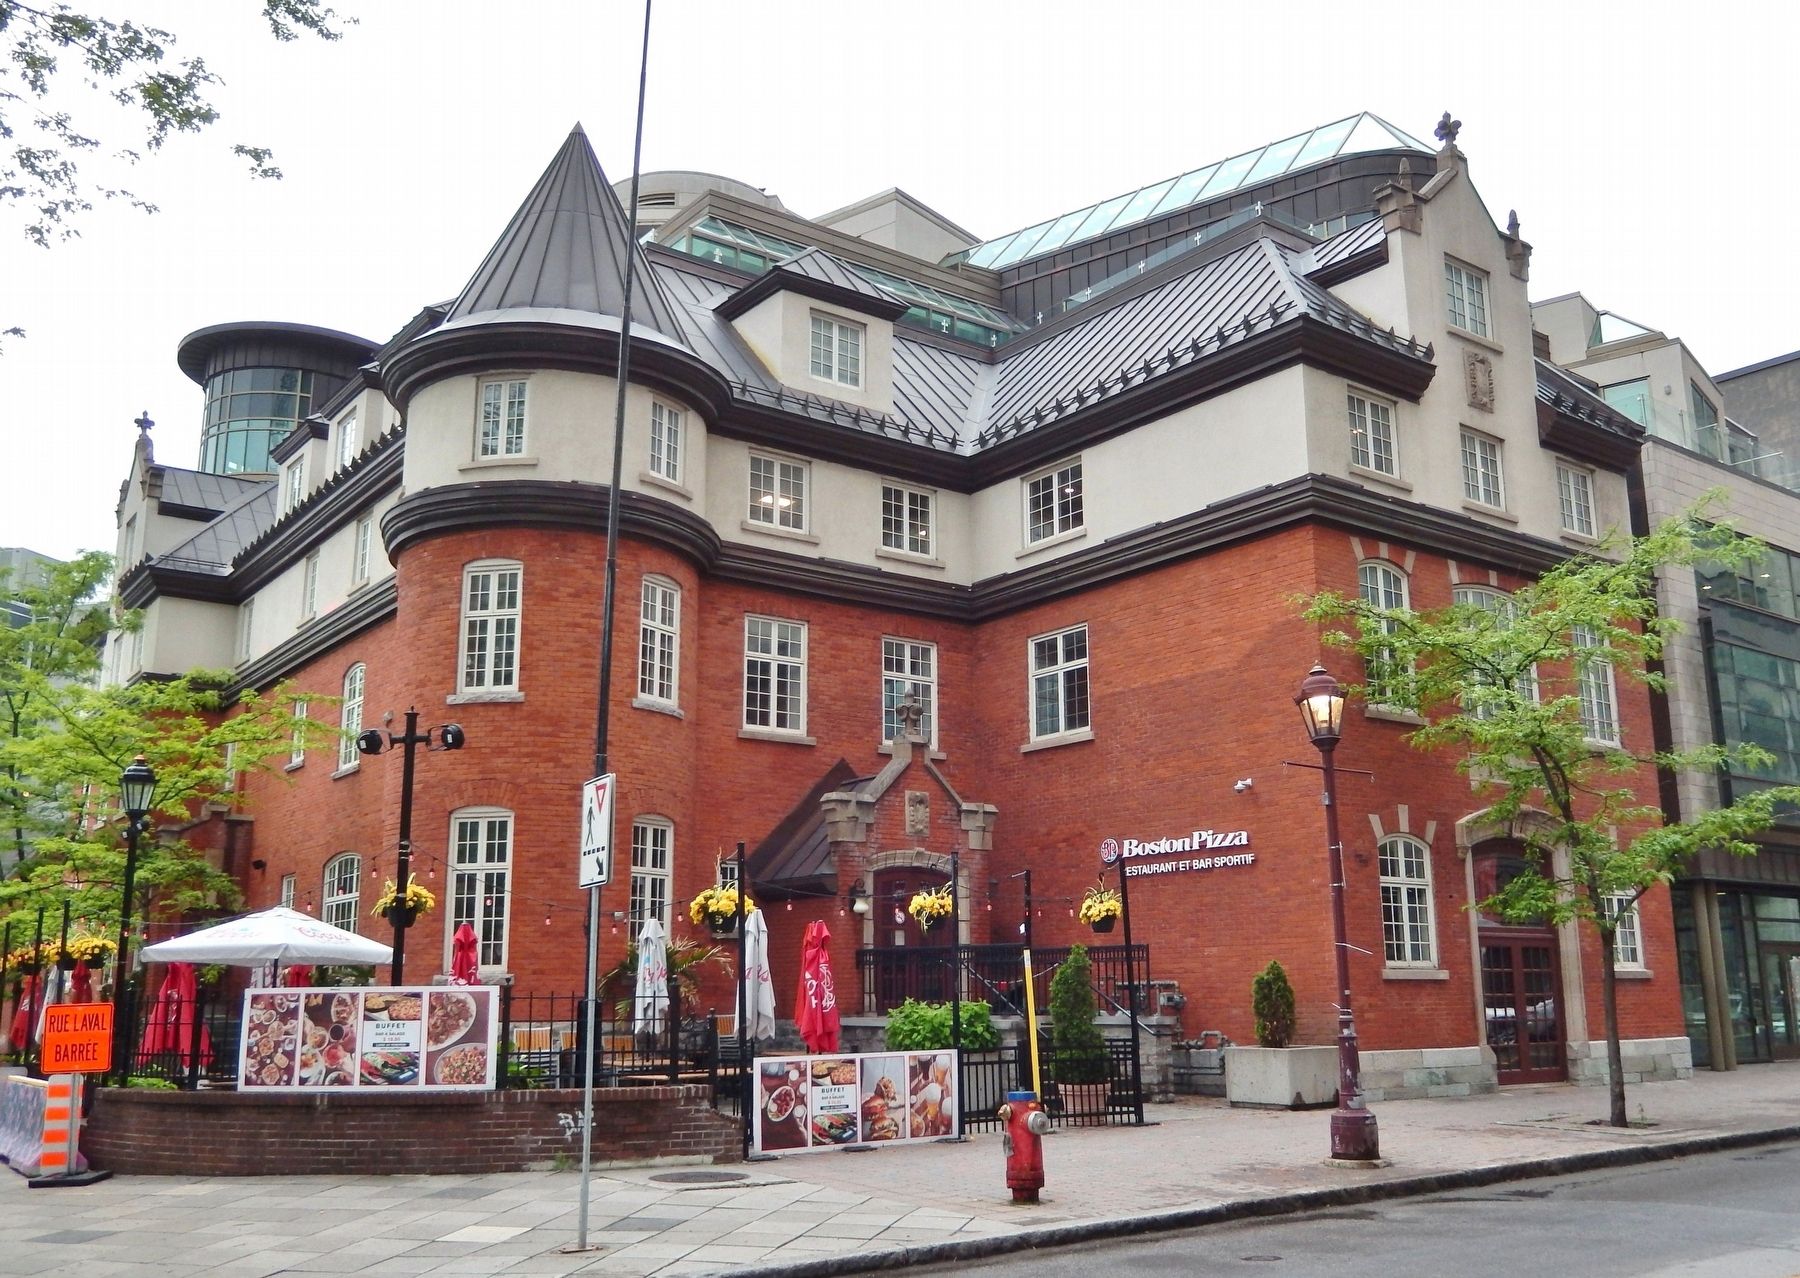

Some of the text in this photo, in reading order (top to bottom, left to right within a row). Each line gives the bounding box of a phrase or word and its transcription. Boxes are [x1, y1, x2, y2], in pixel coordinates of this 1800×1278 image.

[1122, 829, 1249, 858] Boston Pizza
[1124, 853, 1256, 877] ESTAURANT ET BAR SPORTIF
[48, 1012, 107, 1033] RUE LAVAL
[54, 1038, 99, 1062] BARRÉE
[821, 1086, 845, 1094] BUFFET
